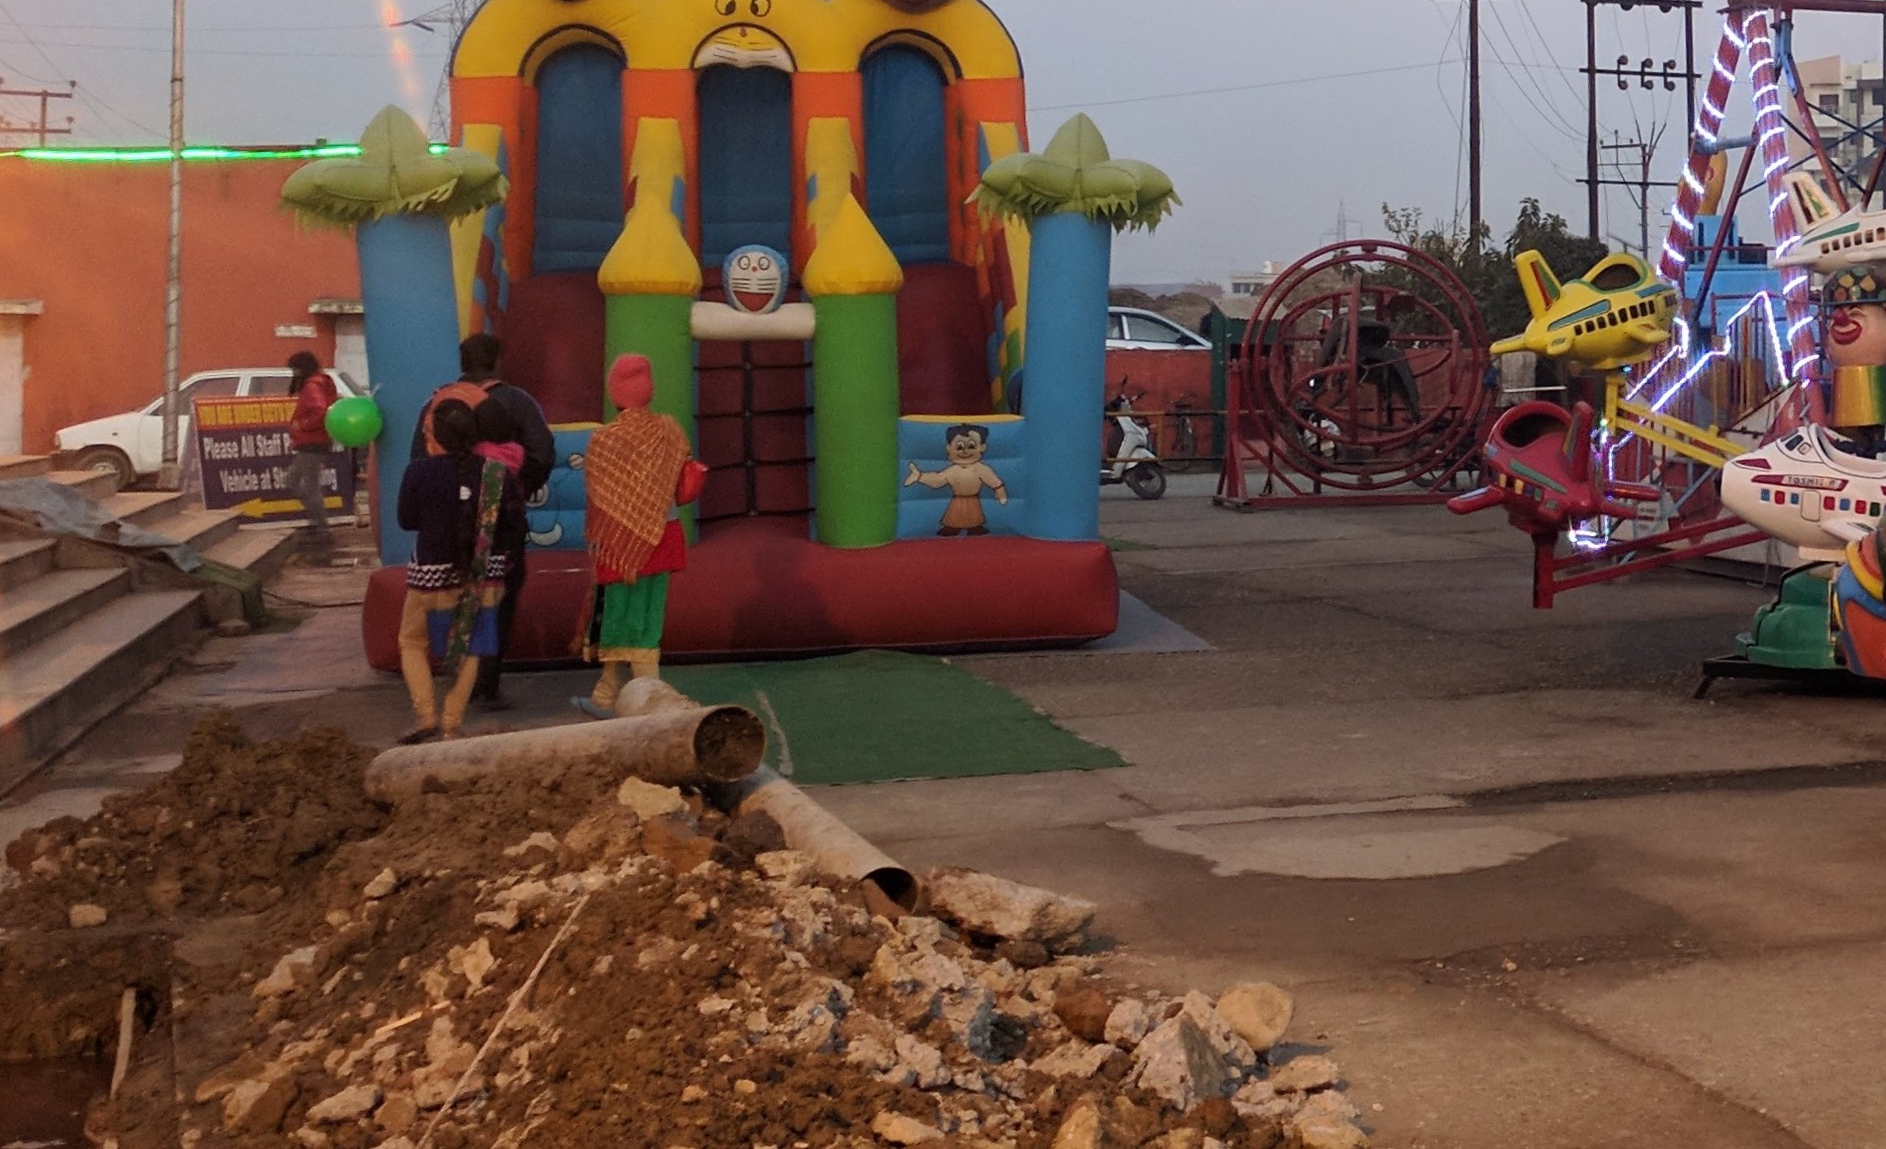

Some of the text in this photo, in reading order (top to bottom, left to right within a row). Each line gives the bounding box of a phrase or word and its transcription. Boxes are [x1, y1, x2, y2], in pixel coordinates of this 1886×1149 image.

[203, 436, 239, 460] Please
[240, 434, 254, 458] All
[256, 432, 282, 457] Staff
[219, 468, 259, 493] Vehicle
[260, 467, 272, 490] at
